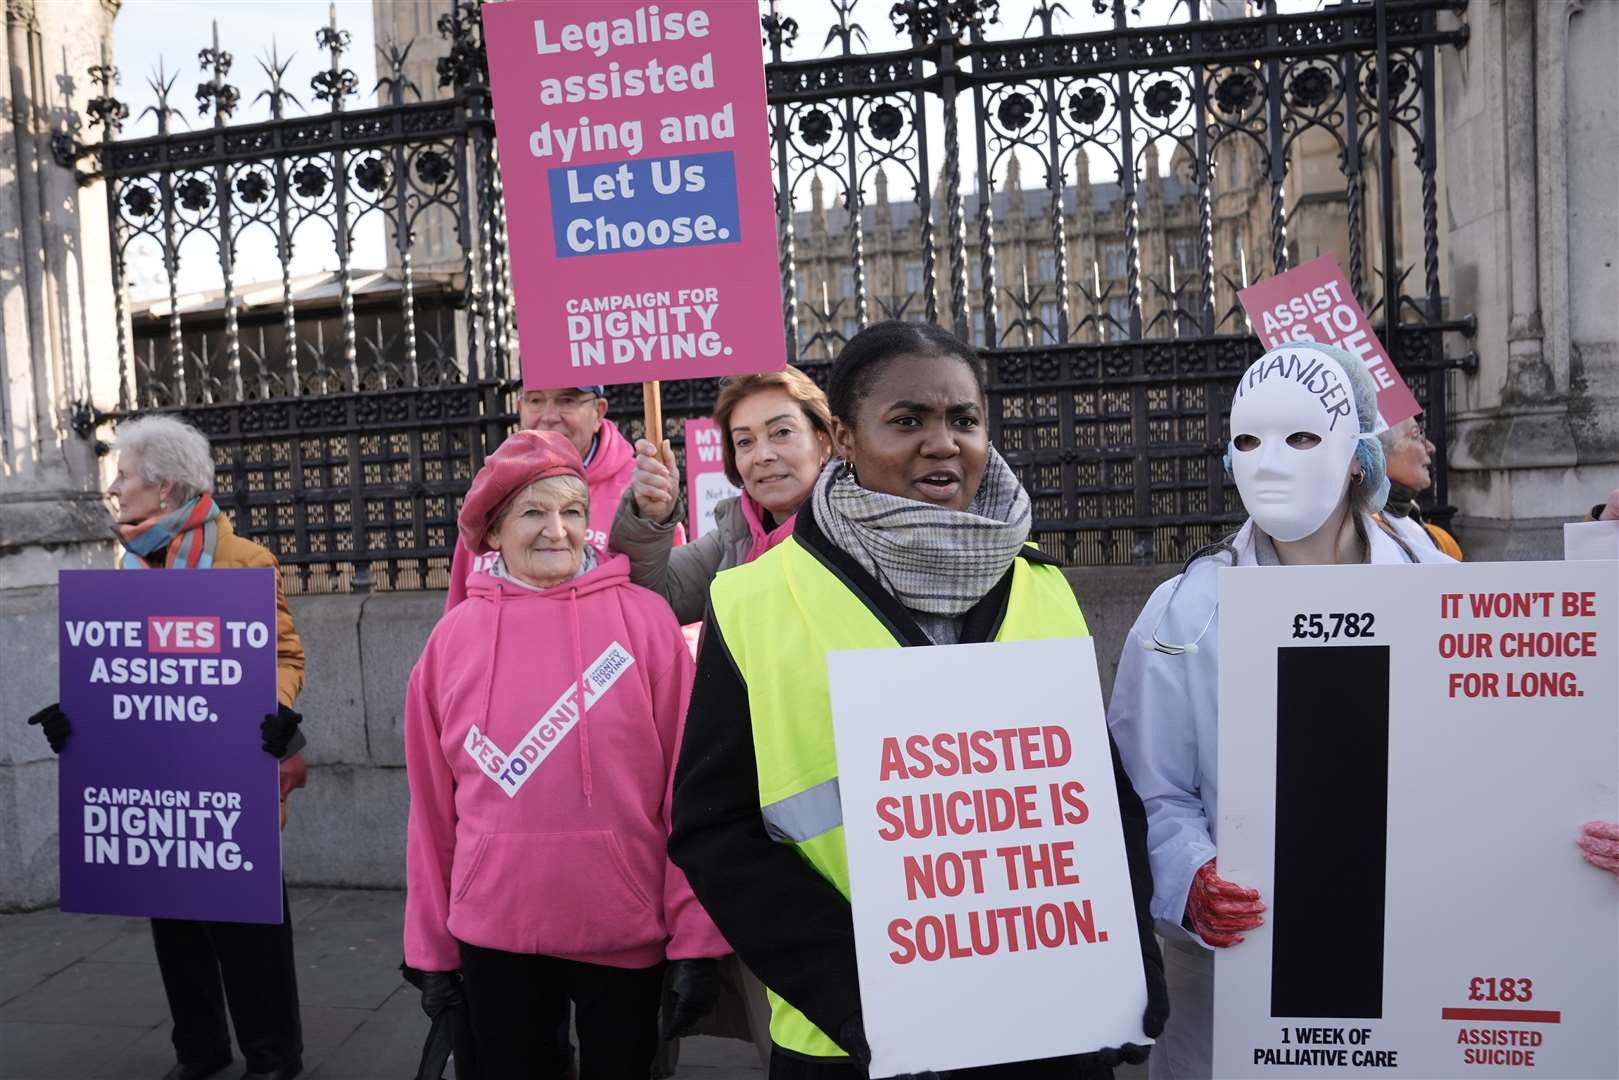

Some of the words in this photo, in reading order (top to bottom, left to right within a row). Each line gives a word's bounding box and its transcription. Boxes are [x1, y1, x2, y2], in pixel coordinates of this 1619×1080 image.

[534, 5, 710, 57] Legalise
[540, 52, 714, 106] assisted
[529, 116, 643, 162] dying
[660, 102, 735, 144] and
[566, 163, 634, 203] Let
[651, 159, 705, 195] Us
[566, 213, 730, 252] Choose.
[566, 291, 670, 314] CAMPAIGN
[678, 288, 718, 304] FOR
[1263, 280, 1341, 334] ASSIST
[567, 303, 719, 341] DIGNITY
[1313, 304, 1357, 340] TO
[570, 340, 605, 367] IN
[613, 332, 733, 365] DYING.
[1441, 593, 1463, 619] IT
[1469, 592, 1555, 618] WON'T
[1562, 591, 1596, 617] BE
[65, 621, 142, 648] VOTE
[153, 622, 216, 648] YES
[226, 622, 269, 649] TO
[1292, 612, 1375, 642] £5,782
[1439, 633, 1493, 658] OUR
[1500, 632, 1597, 657] CHOICE
[89, 658, 242, 685] ASSISTED
[1449, 673, 1499, 698] FOR
[1507, 672, 1585, 697] LONG.
[113, 694, 218, 723] DYING.
[471, 733, 504, 774] YES
[879, 725, 1072, 781] ASSISTED
[83, 787, 190, 807] CAMPAIGN
[199, 791, 241, 809] FOR
[876, 785, 1042, 842] SUICIDE
[1050, 781, 1090, 826] IS
[84, 806, 241, 840] DIGNITY
[84, 836, 120, 864] IN
[127, 840, 254, 871] DYING.
[903, 849, 987, 901] NOT
[996, 841, 1080, 891] THE
[887, 900, 1108, 965] SOLUTION.
[1468, 976, 1533, 1002] £183
[1281, 1027, 1290, 1044] 1
[1295, 1028, 1347, 1045] WEEK
[1349, 1028, 1372, 1045] OF
[1457, 1029, 1543, 1047] ASSISTED
[1253, 1048, 1348, 1066] PALLIATIVE
[1351, 1050, 1398, 1068] CARE
[1464, 1049, 1536, 1066] SUICIDE
